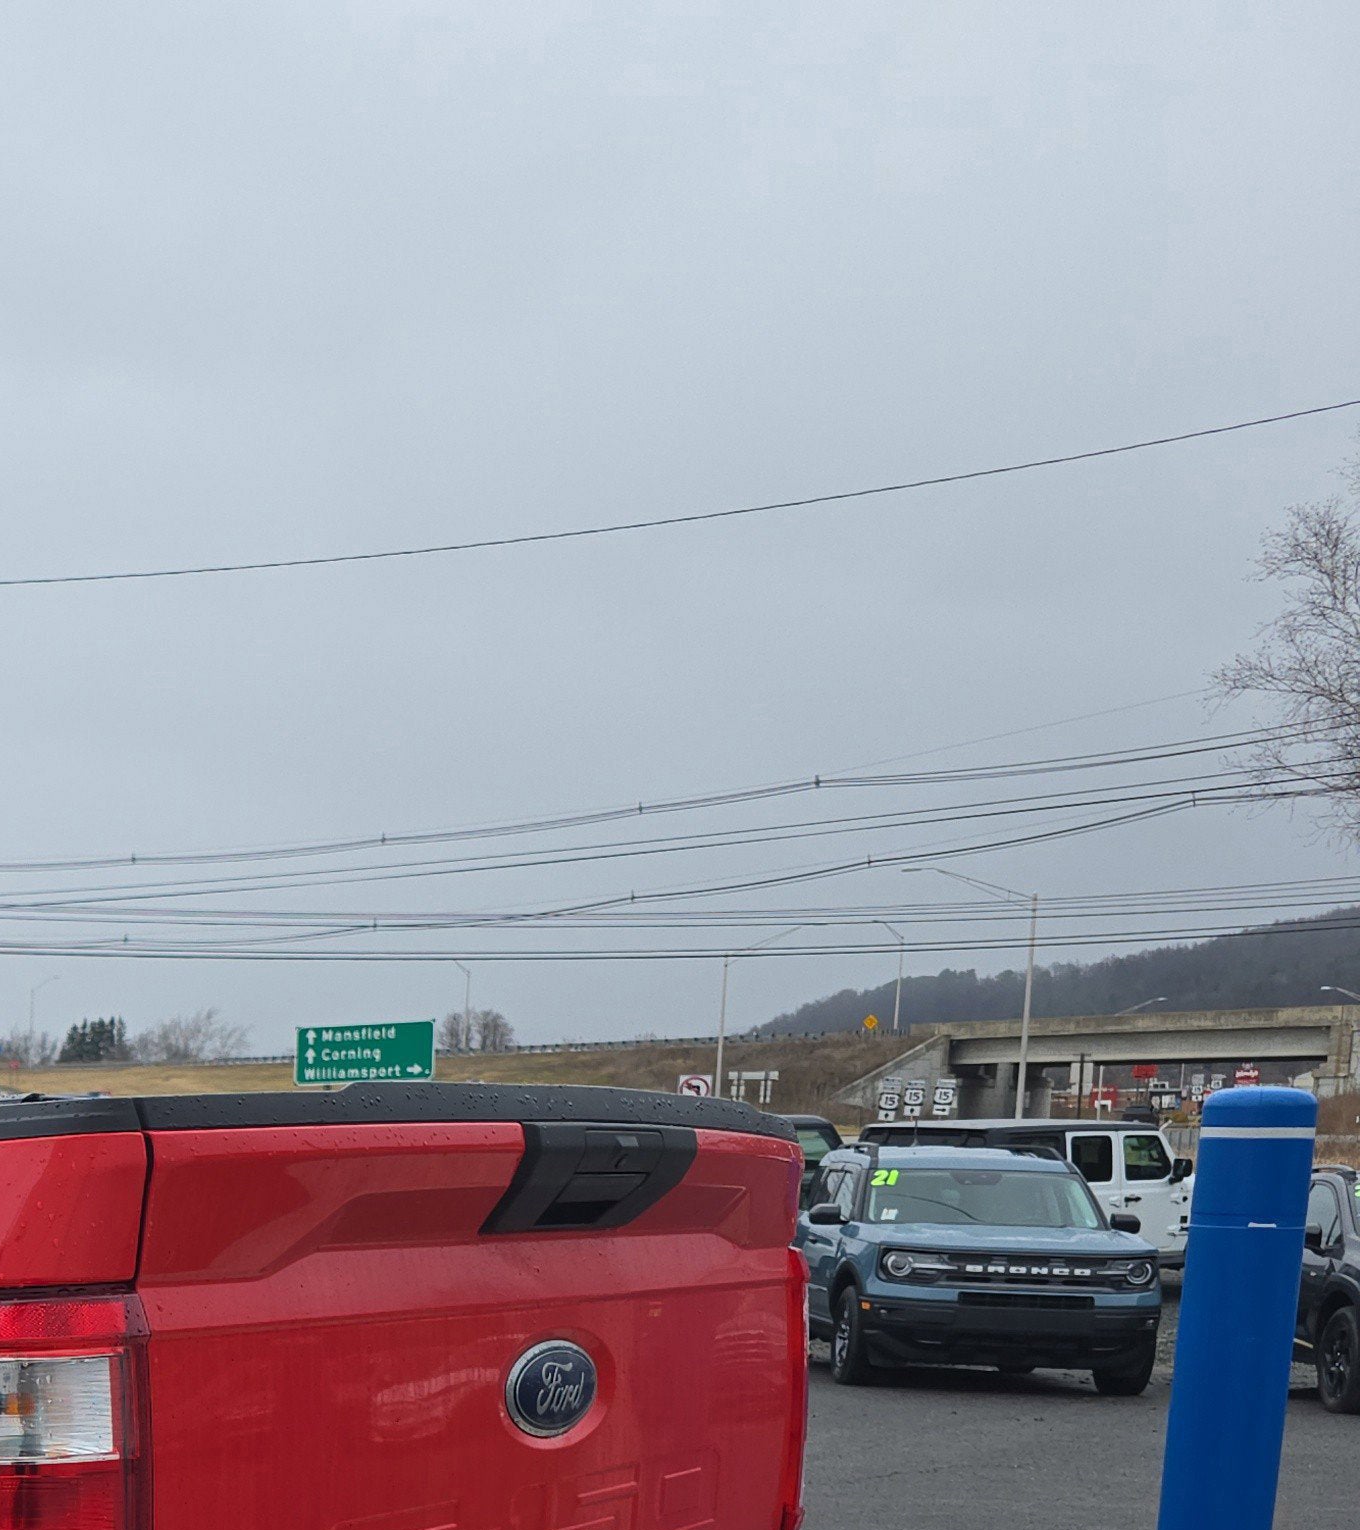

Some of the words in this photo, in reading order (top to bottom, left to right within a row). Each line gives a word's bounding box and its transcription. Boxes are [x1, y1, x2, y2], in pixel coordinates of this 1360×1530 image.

[321, 1026, 396, 1042] Mansfield
[321, 1047, 381, 1062] Corning
[304, 1064, 401, 1080] Williamsport
[884, 1096, 896, 1106] 15
[909, 1091, 920, 1102] 15
[939, 1090, 950, 1101] 15
[870, 1169, 899, 1186] 21
[965, 1264, 1091, 1276] BRONCO
[537, 1362, 585, 1415] Ford
